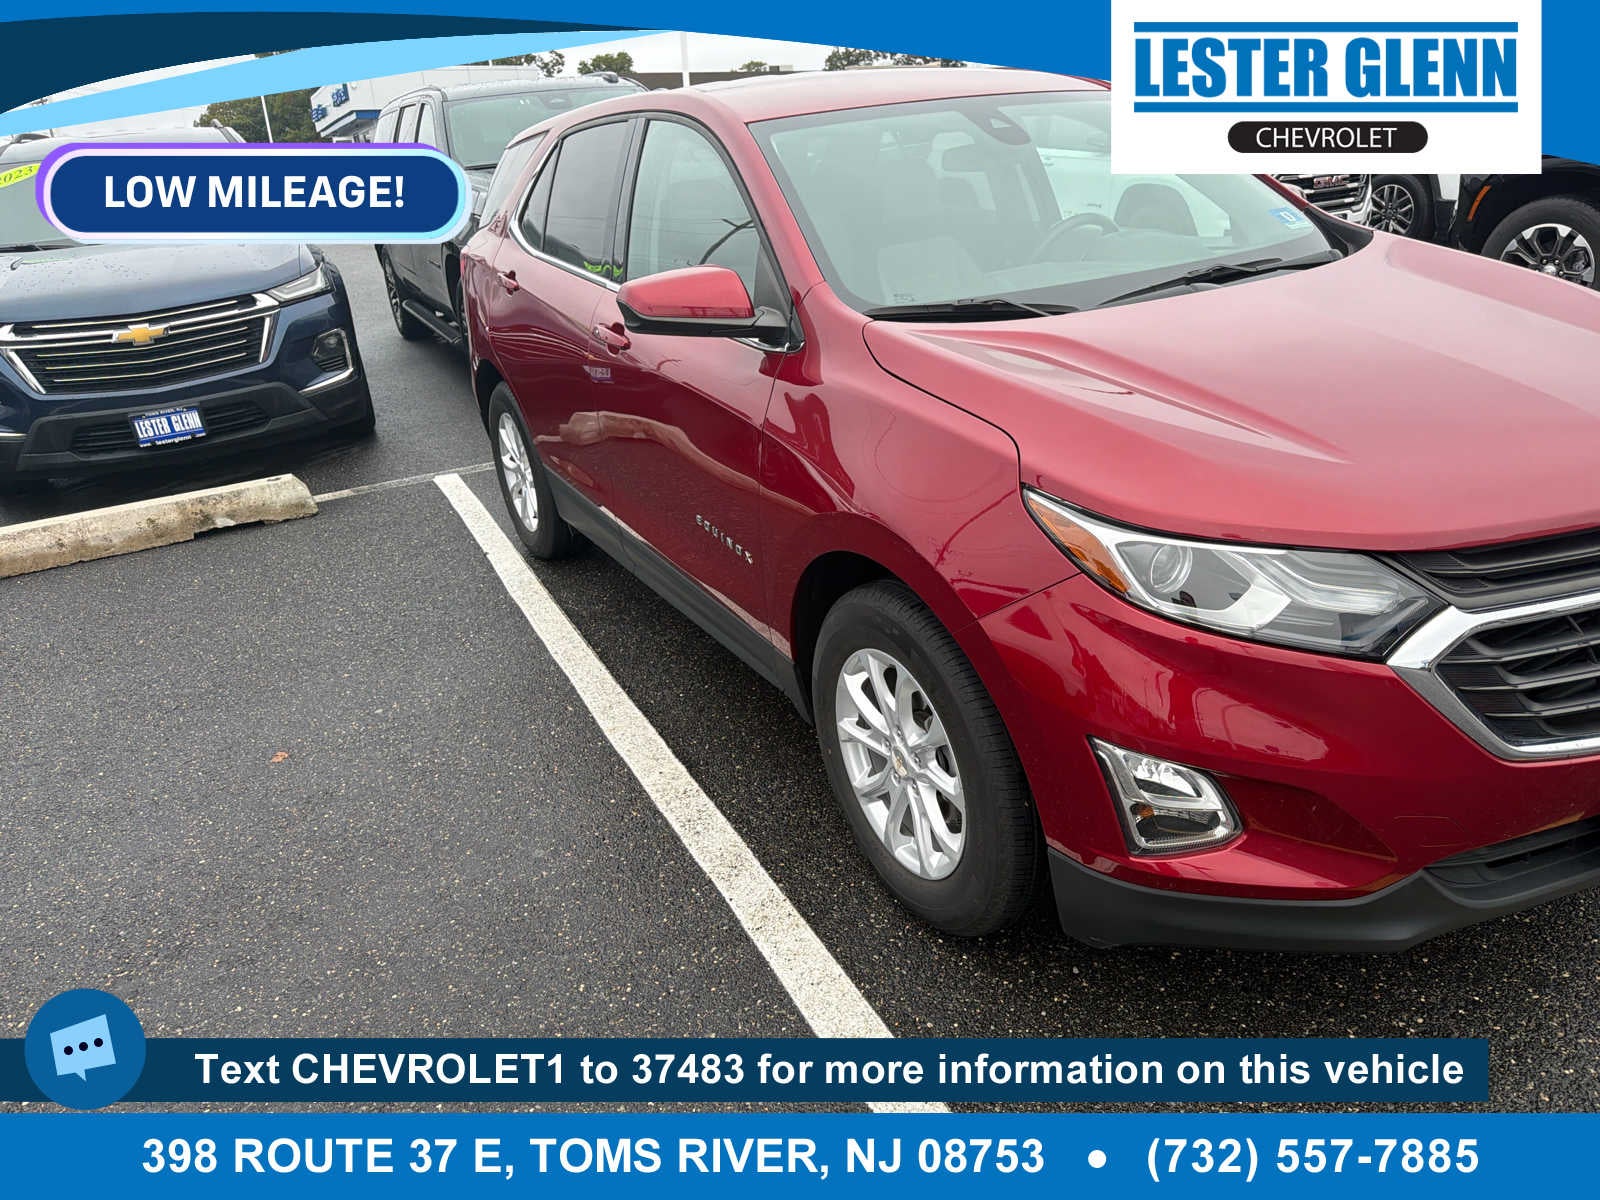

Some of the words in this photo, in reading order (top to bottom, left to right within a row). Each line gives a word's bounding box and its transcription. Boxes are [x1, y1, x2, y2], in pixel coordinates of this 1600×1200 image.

[134, 417, 171, 438] LESTER
[170, 410, 202, 432] GLENN
[696, 514, 753, 565] EQUINOX
